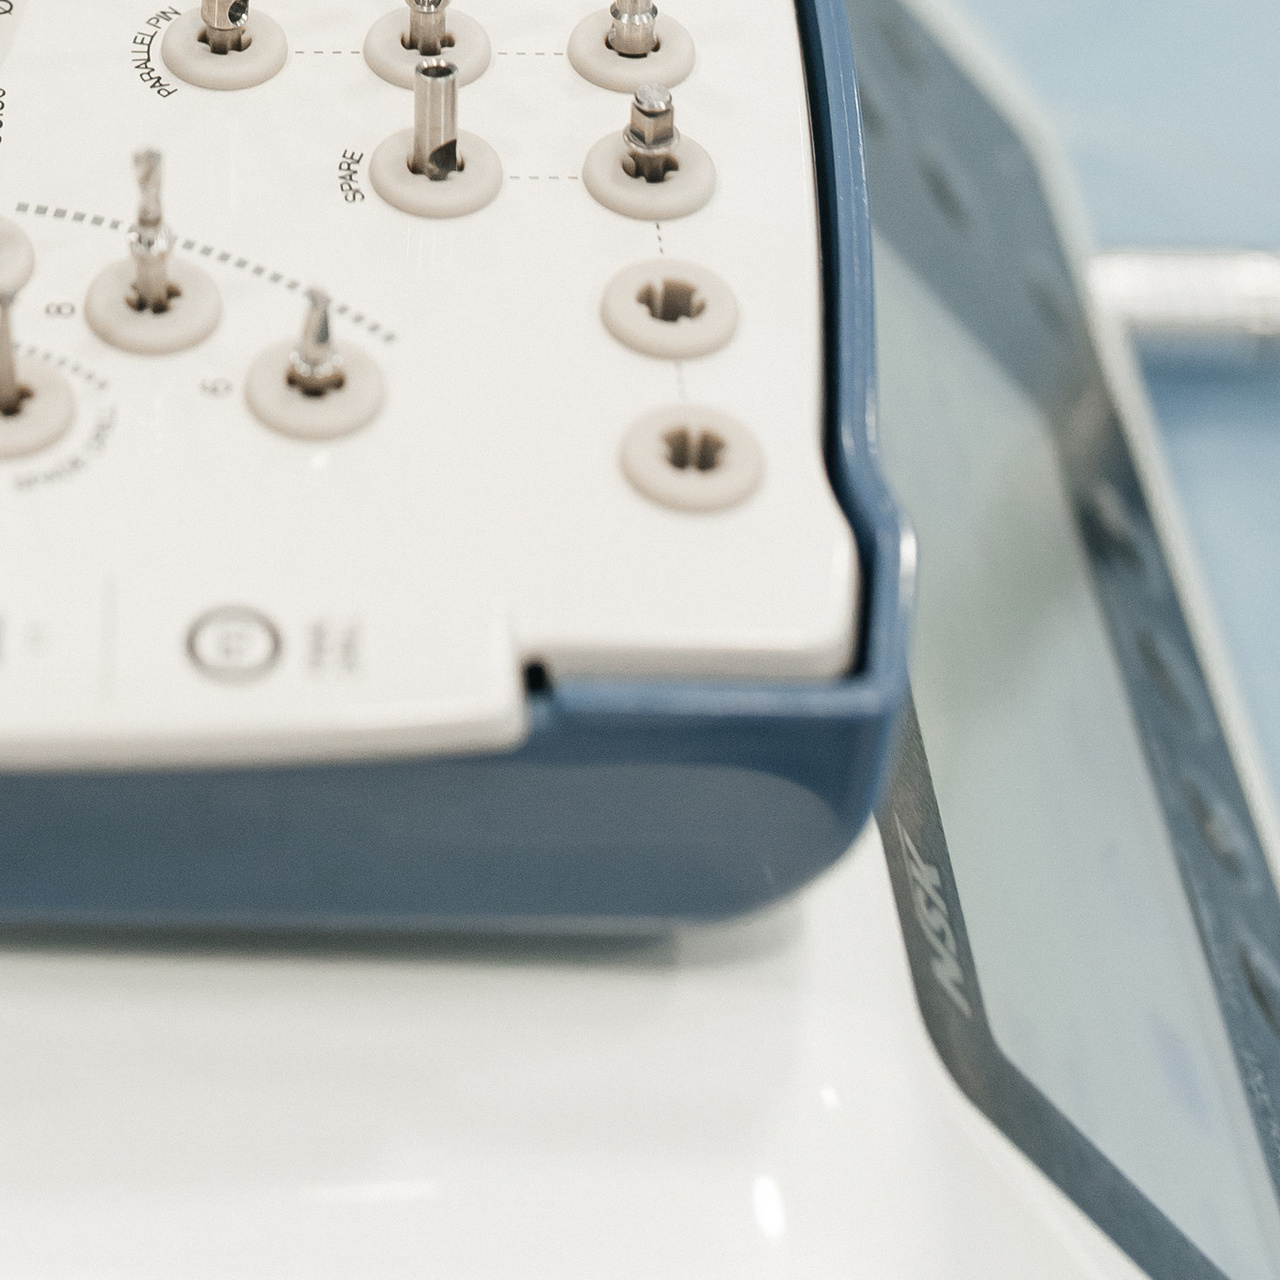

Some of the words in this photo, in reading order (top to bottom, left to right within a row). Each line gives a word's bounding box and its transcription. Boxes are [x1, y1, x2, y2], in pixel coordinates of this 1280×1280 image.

[146, 6, 182, 29] PIN
[131, 30, 178, 98] PARALLEL
[338, 149, 364, 204] SPARE
[45, 301, 75, 318] 8
